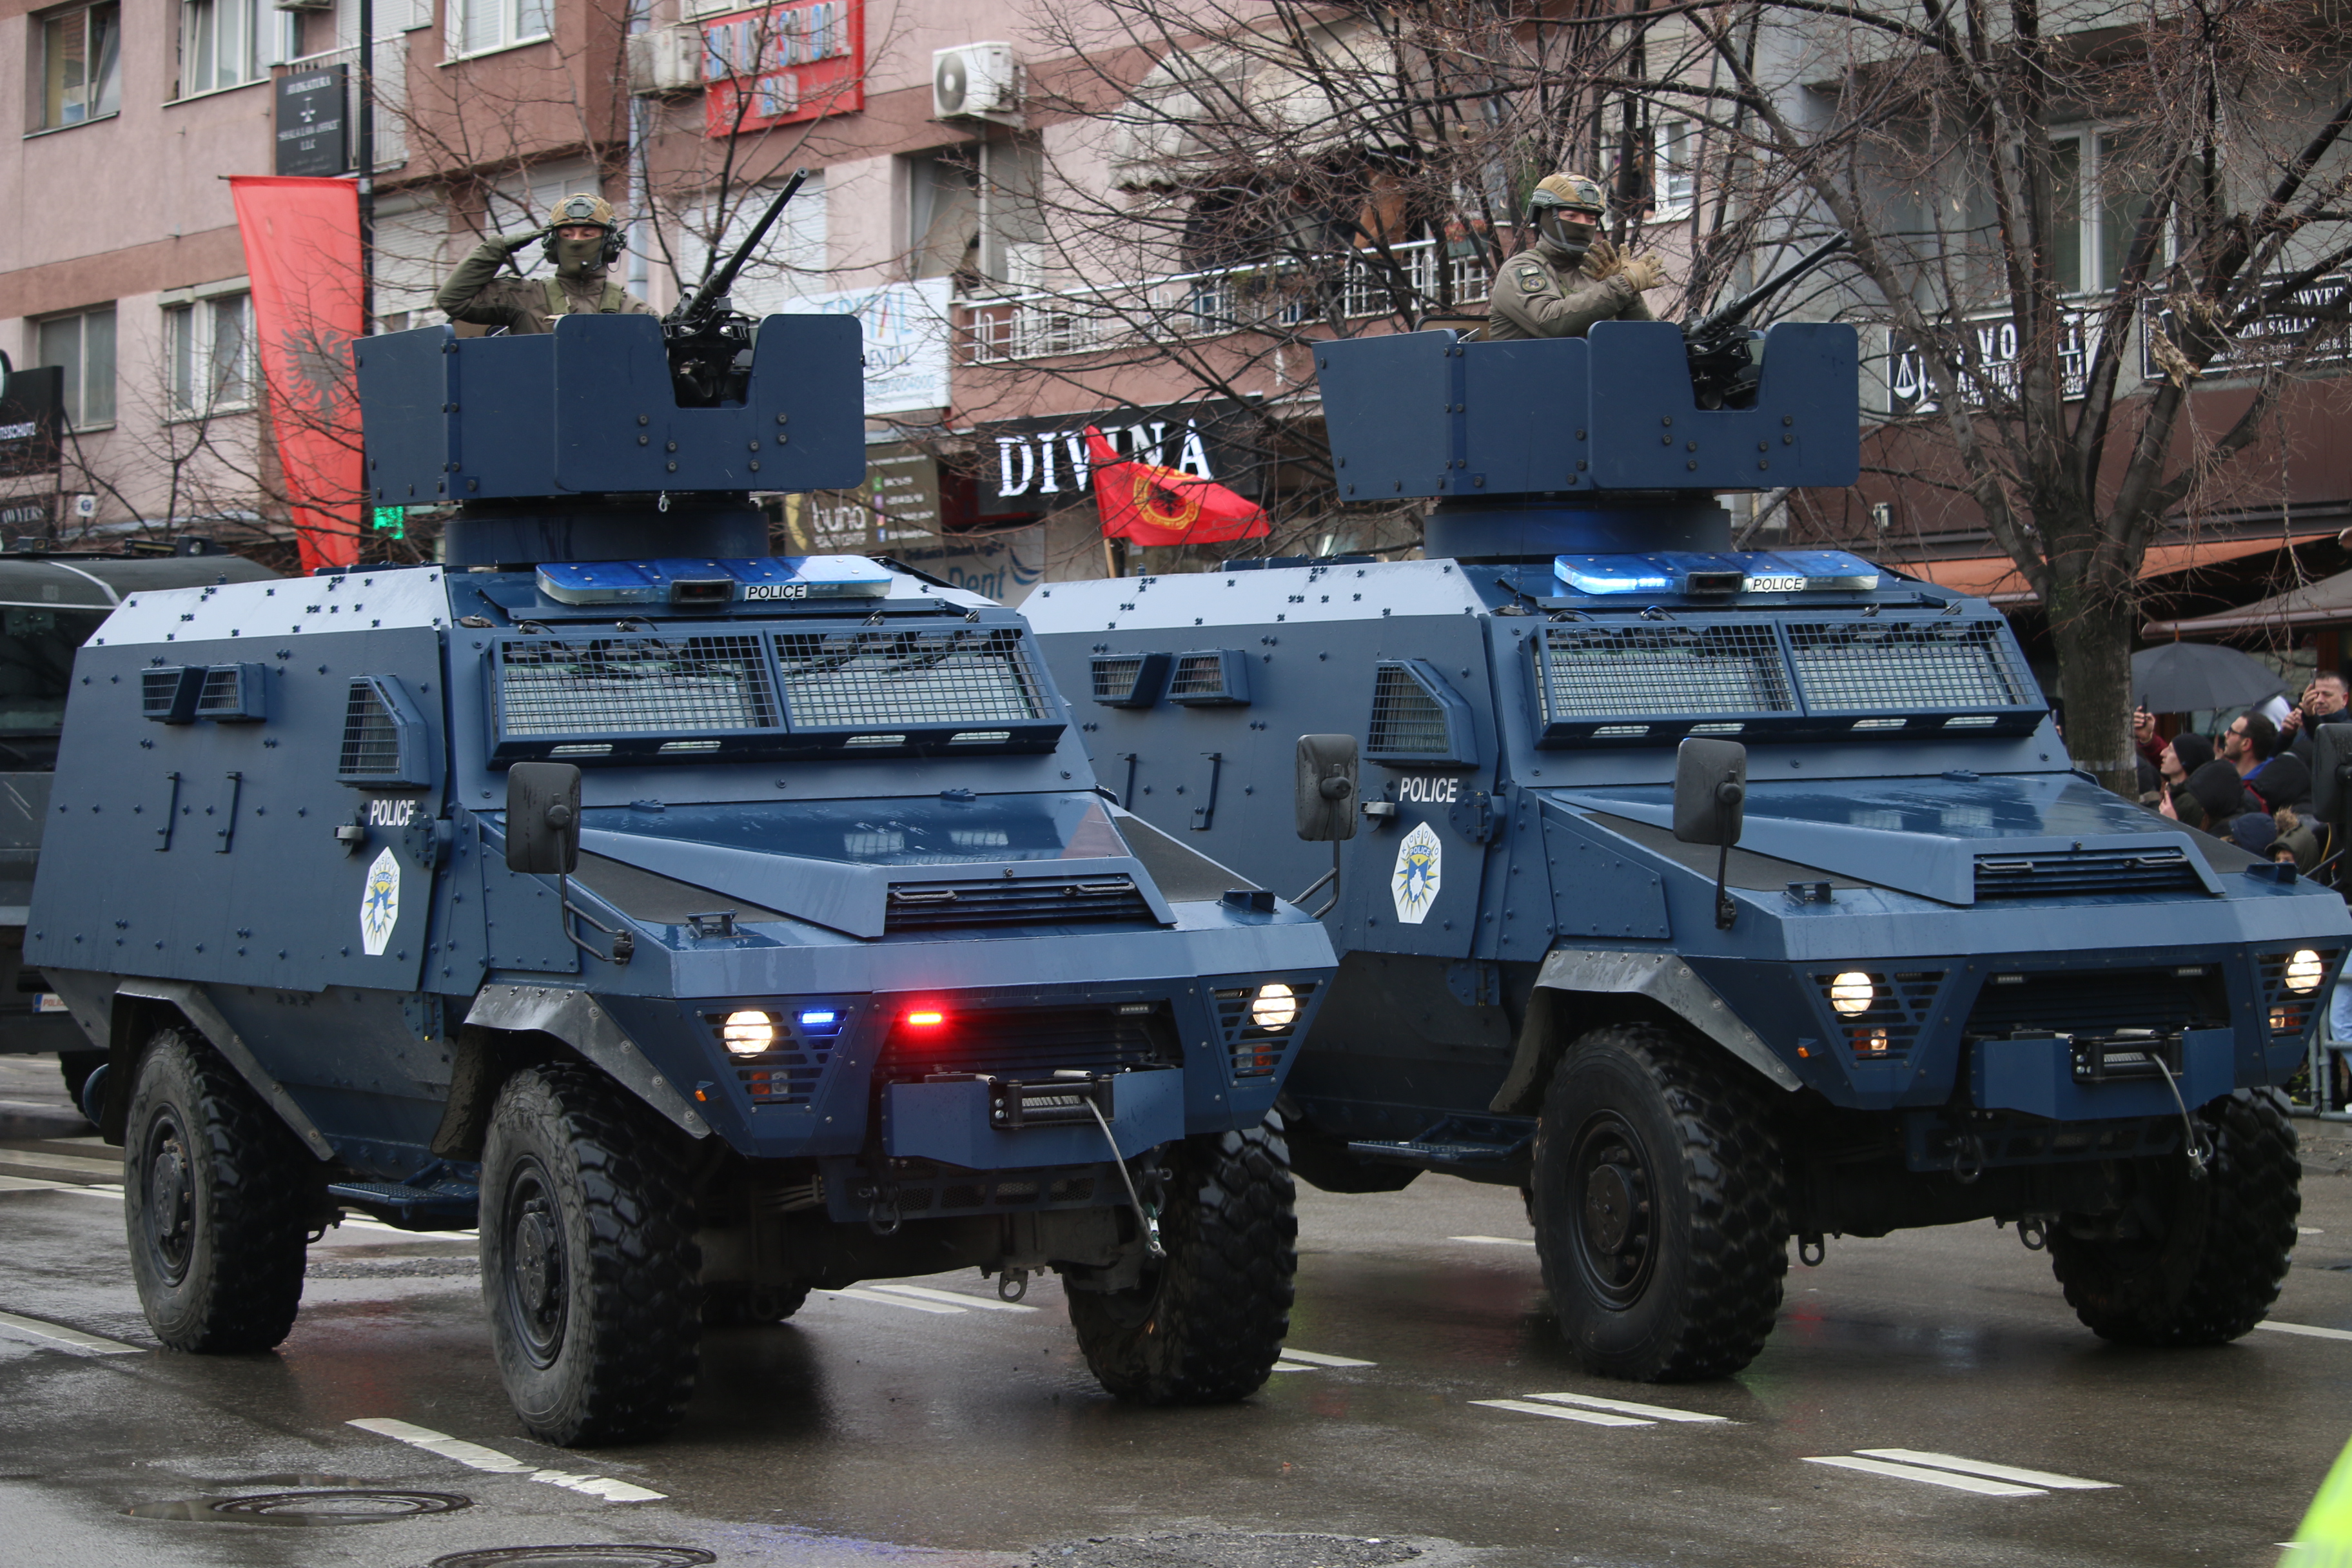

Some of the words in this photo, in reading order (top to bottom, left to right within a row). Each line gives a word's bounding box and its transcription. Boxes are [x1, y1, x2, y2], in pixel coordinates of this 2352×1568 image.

[778, 1, 852, 67] SCHOOL
[995, 418, 1215, 497] DIVINA
[748, 585, 805, 599] POLICE
[949, 563, 1006, 600] Dent
[1753, 578, 1803, 591] POLICE
[1398, 777, 1458, 803] POLICE
[369, 799, 416, 827] POLICE
[1402, 830, 1439, 856] KOSOVO
[1409, 845, 1431, 858] POLICE
[369, 856, 398, 882] KOSOVO
[375, 872, 393, 884] POLICE
